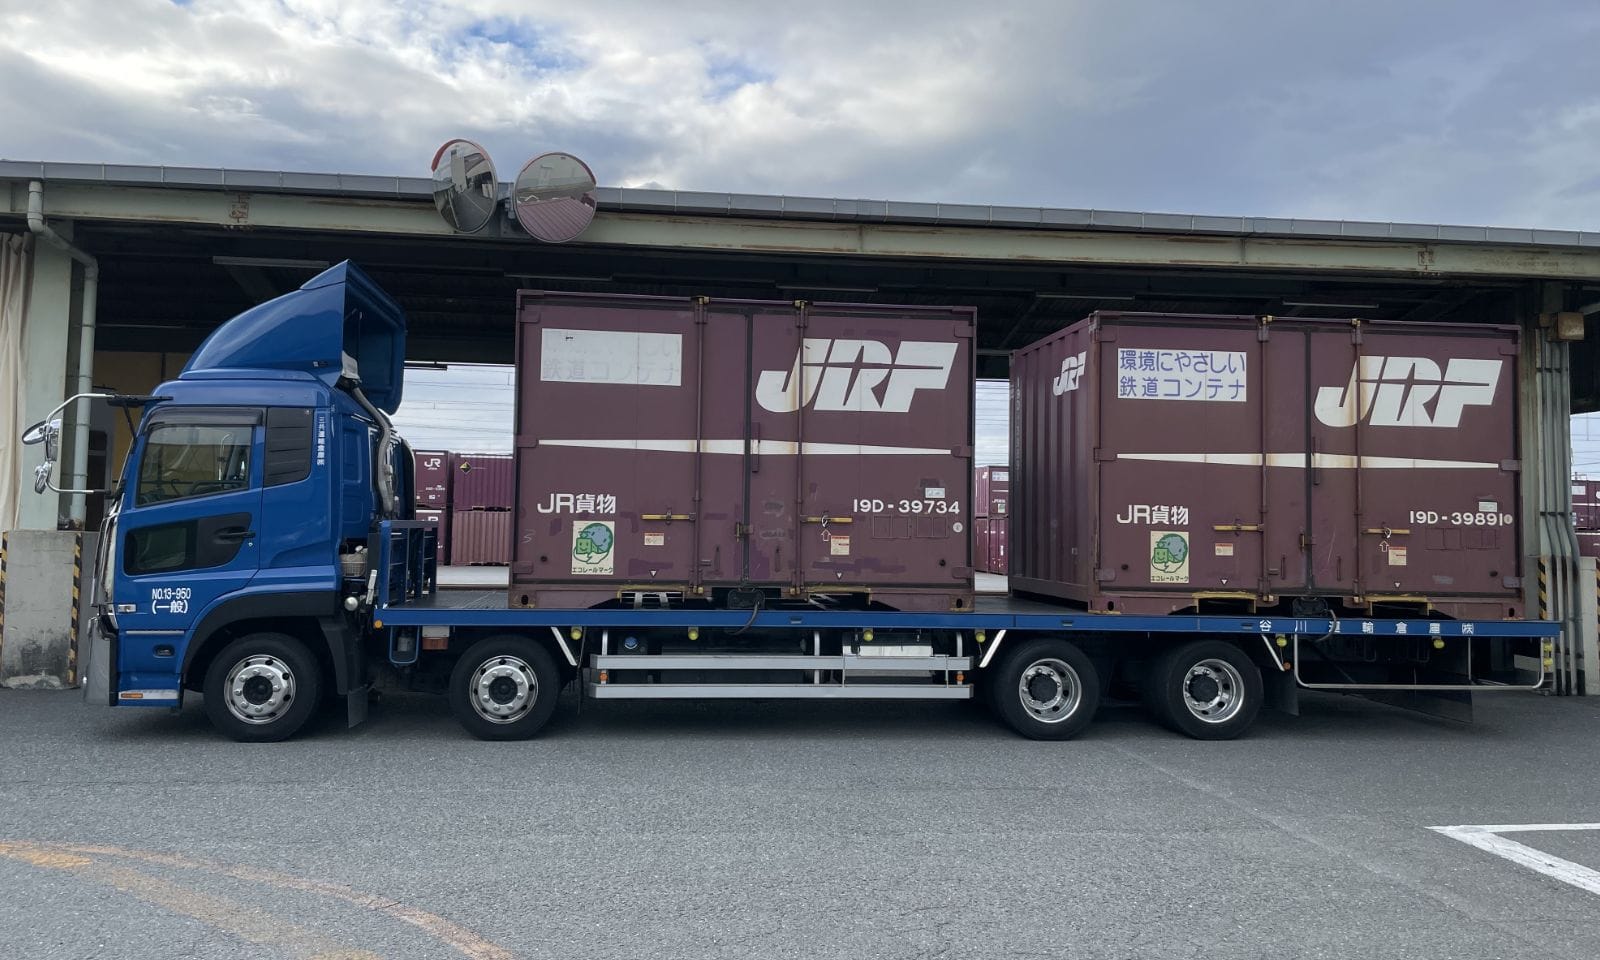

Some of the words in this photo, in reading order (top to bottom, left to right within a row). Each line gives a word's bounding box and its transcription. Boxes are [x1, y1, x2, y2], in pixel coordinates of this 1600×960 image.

[1119, 350, 1246, 374] 環境にやさしい
[755, 338, 958, 413] JRF
[1052, 351, 1087, 396] JRF
[1119, 376, 1246, 401] 鉄道コンテナ
[1314, 356, 1503, 428] JRF
[424, 458, 442, 469] JR
[537, 493, 616, 514] JR貨物
[853, 498, 961, 515] 19D-39734
[1116, 504, 1190, 525] JR貨物
[1409, 509, 1502, 527] 19D-39891
[572, 566, 614, 574] エコレールマーク
